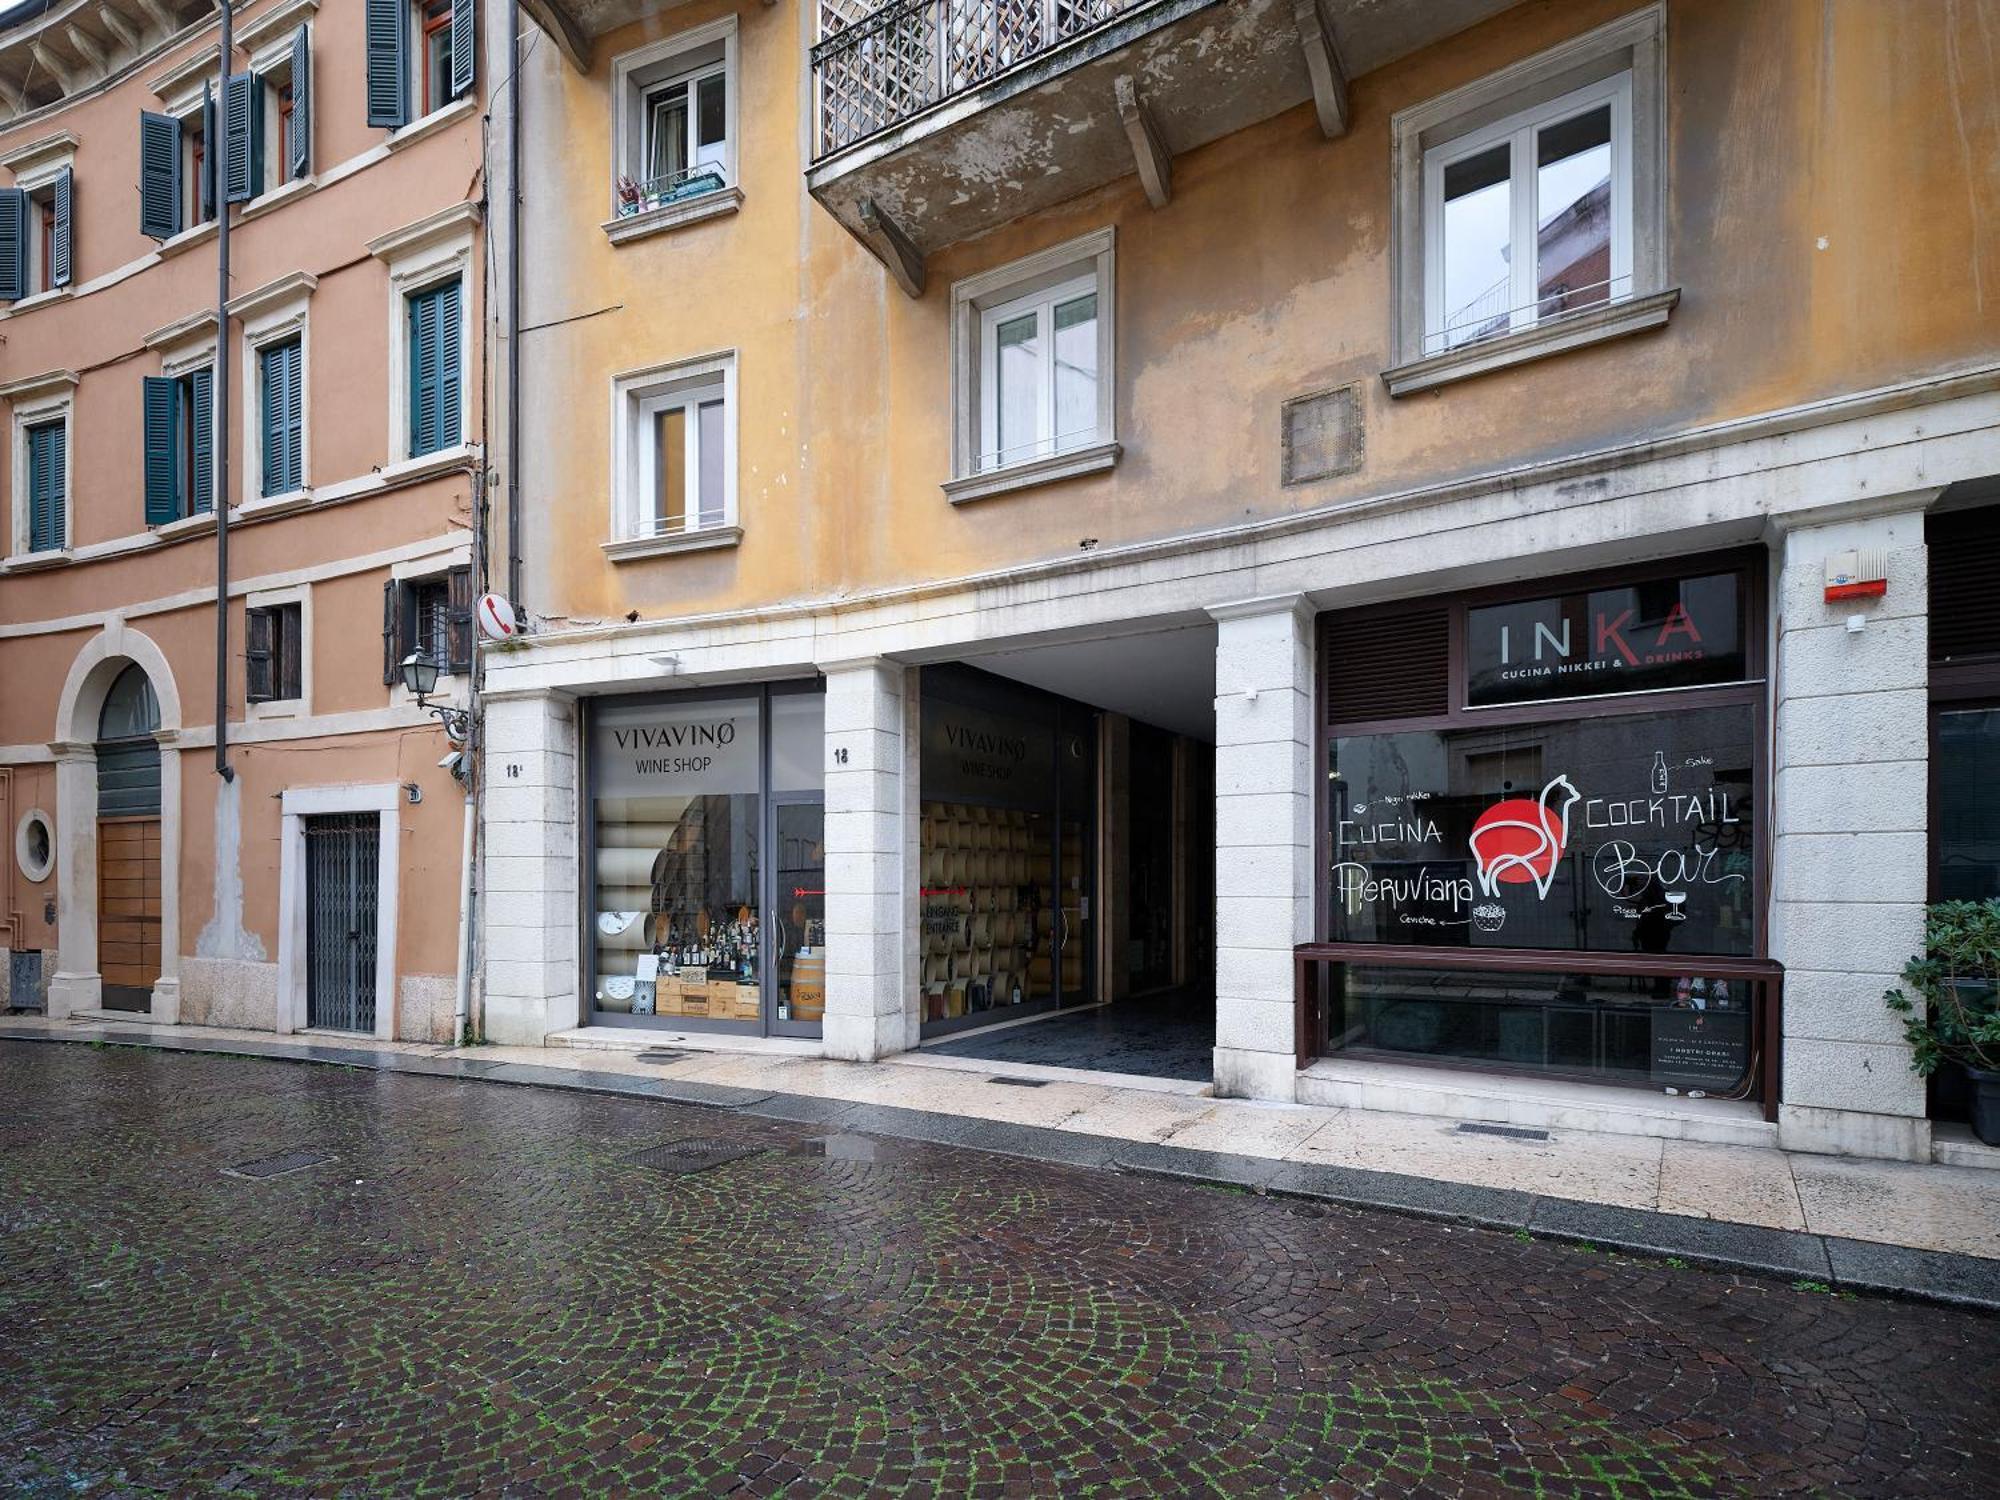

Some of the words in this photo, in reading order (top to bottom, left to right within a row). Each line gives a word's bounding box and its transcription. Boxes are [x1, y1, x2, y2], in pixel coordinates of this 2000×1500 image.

[1501, 602, 1703, 666] INKA
[1501, 666, 1552, 680] CUCINA
[1558, 660, 1606, 674] NIKKEI
[1613, 658, 1623, 668] &
[1645, 649, 1704, 664] DRINKS
[636, 758, 670, 774] WINE
[674, 756, 712, 773] SHOP
[834, 748, 849, 764] 18
[1685, 755, 1714, 768] Sake
[960, 759, 985, 777] WINE
[1592, 839, 1745, 900] Bar
